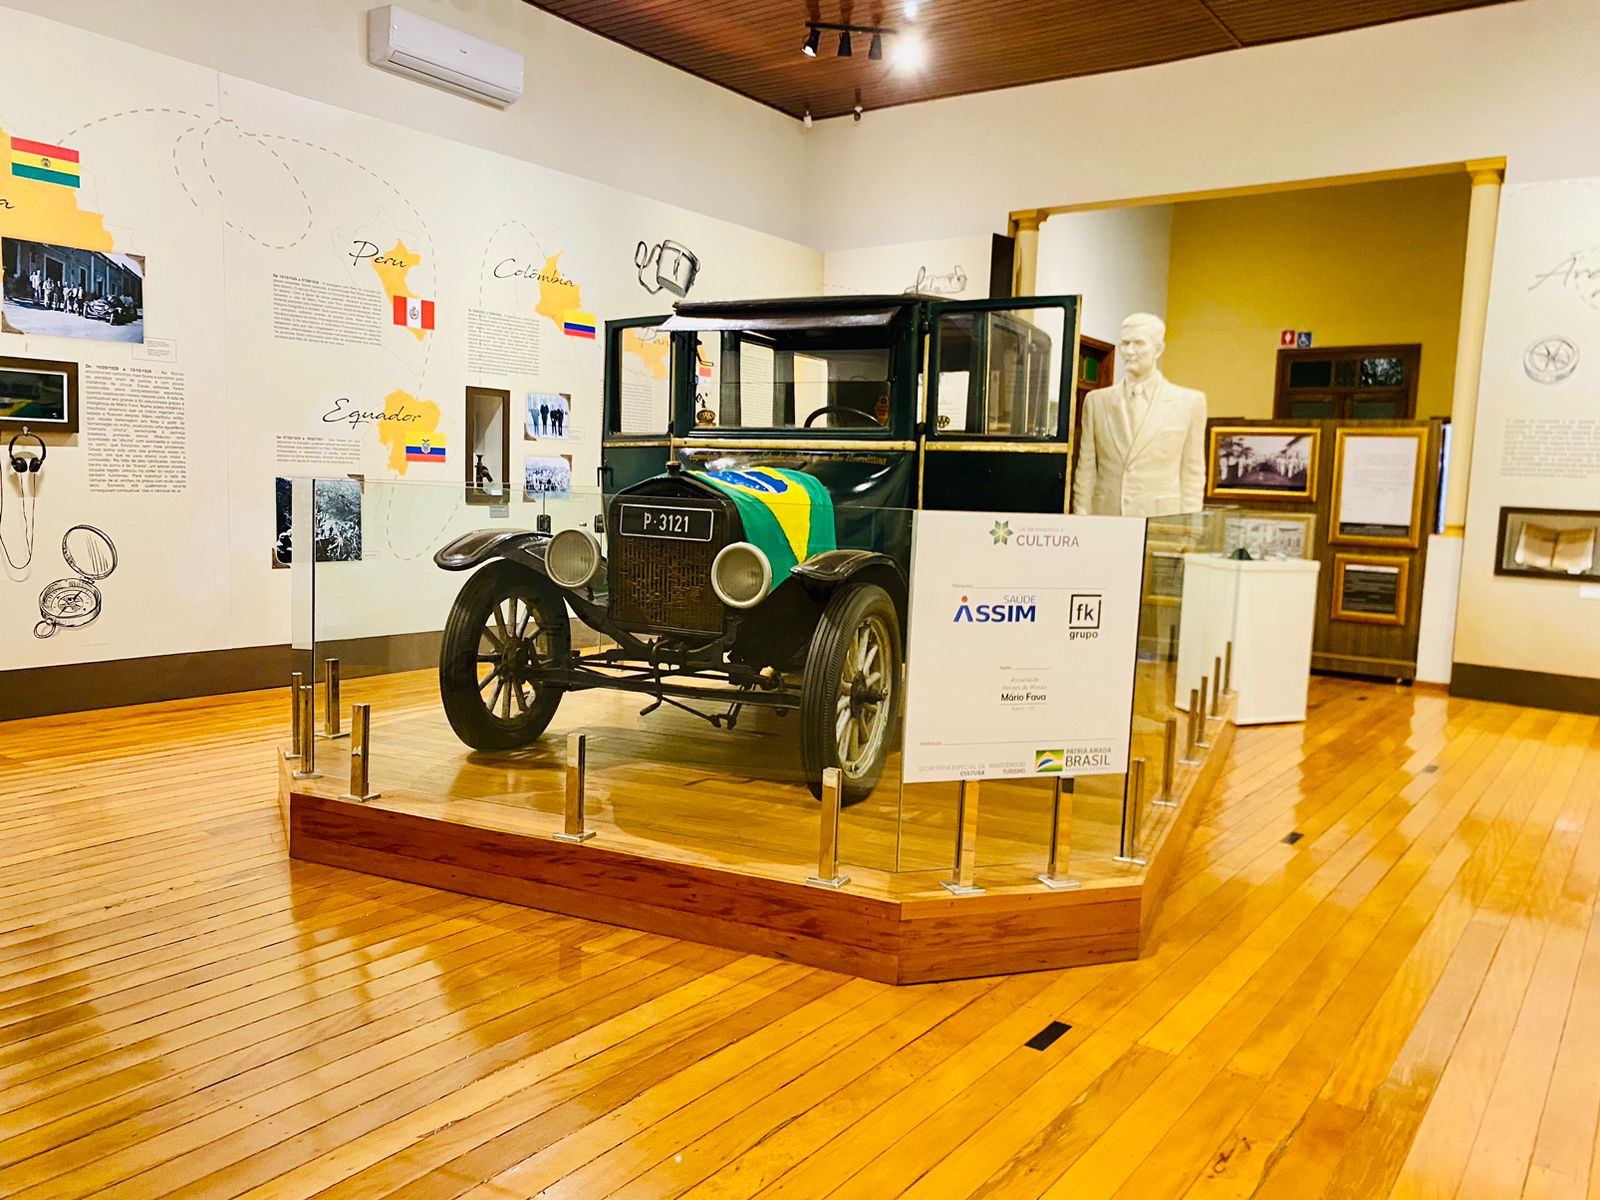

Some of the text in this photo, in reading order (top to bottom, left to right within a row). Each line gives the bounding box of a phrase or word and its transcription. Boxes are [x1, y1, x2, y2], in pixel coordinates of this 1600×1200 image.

[348, 240, 407, 267] Peru
[493, 257, 575, 287] Colômbia
[322, 397, 421, 430] Equador
[1016, 534, 1080, 548] CULTURA
[1077, 603, 1095, 621] fk
[1069, 631, 1099, 641] grupo
[1000, 692, 1047, 702] Mário Fava
[1065, 754, 1111, 767] BRASIL
[960, 769, 985, 777] CULTURA
